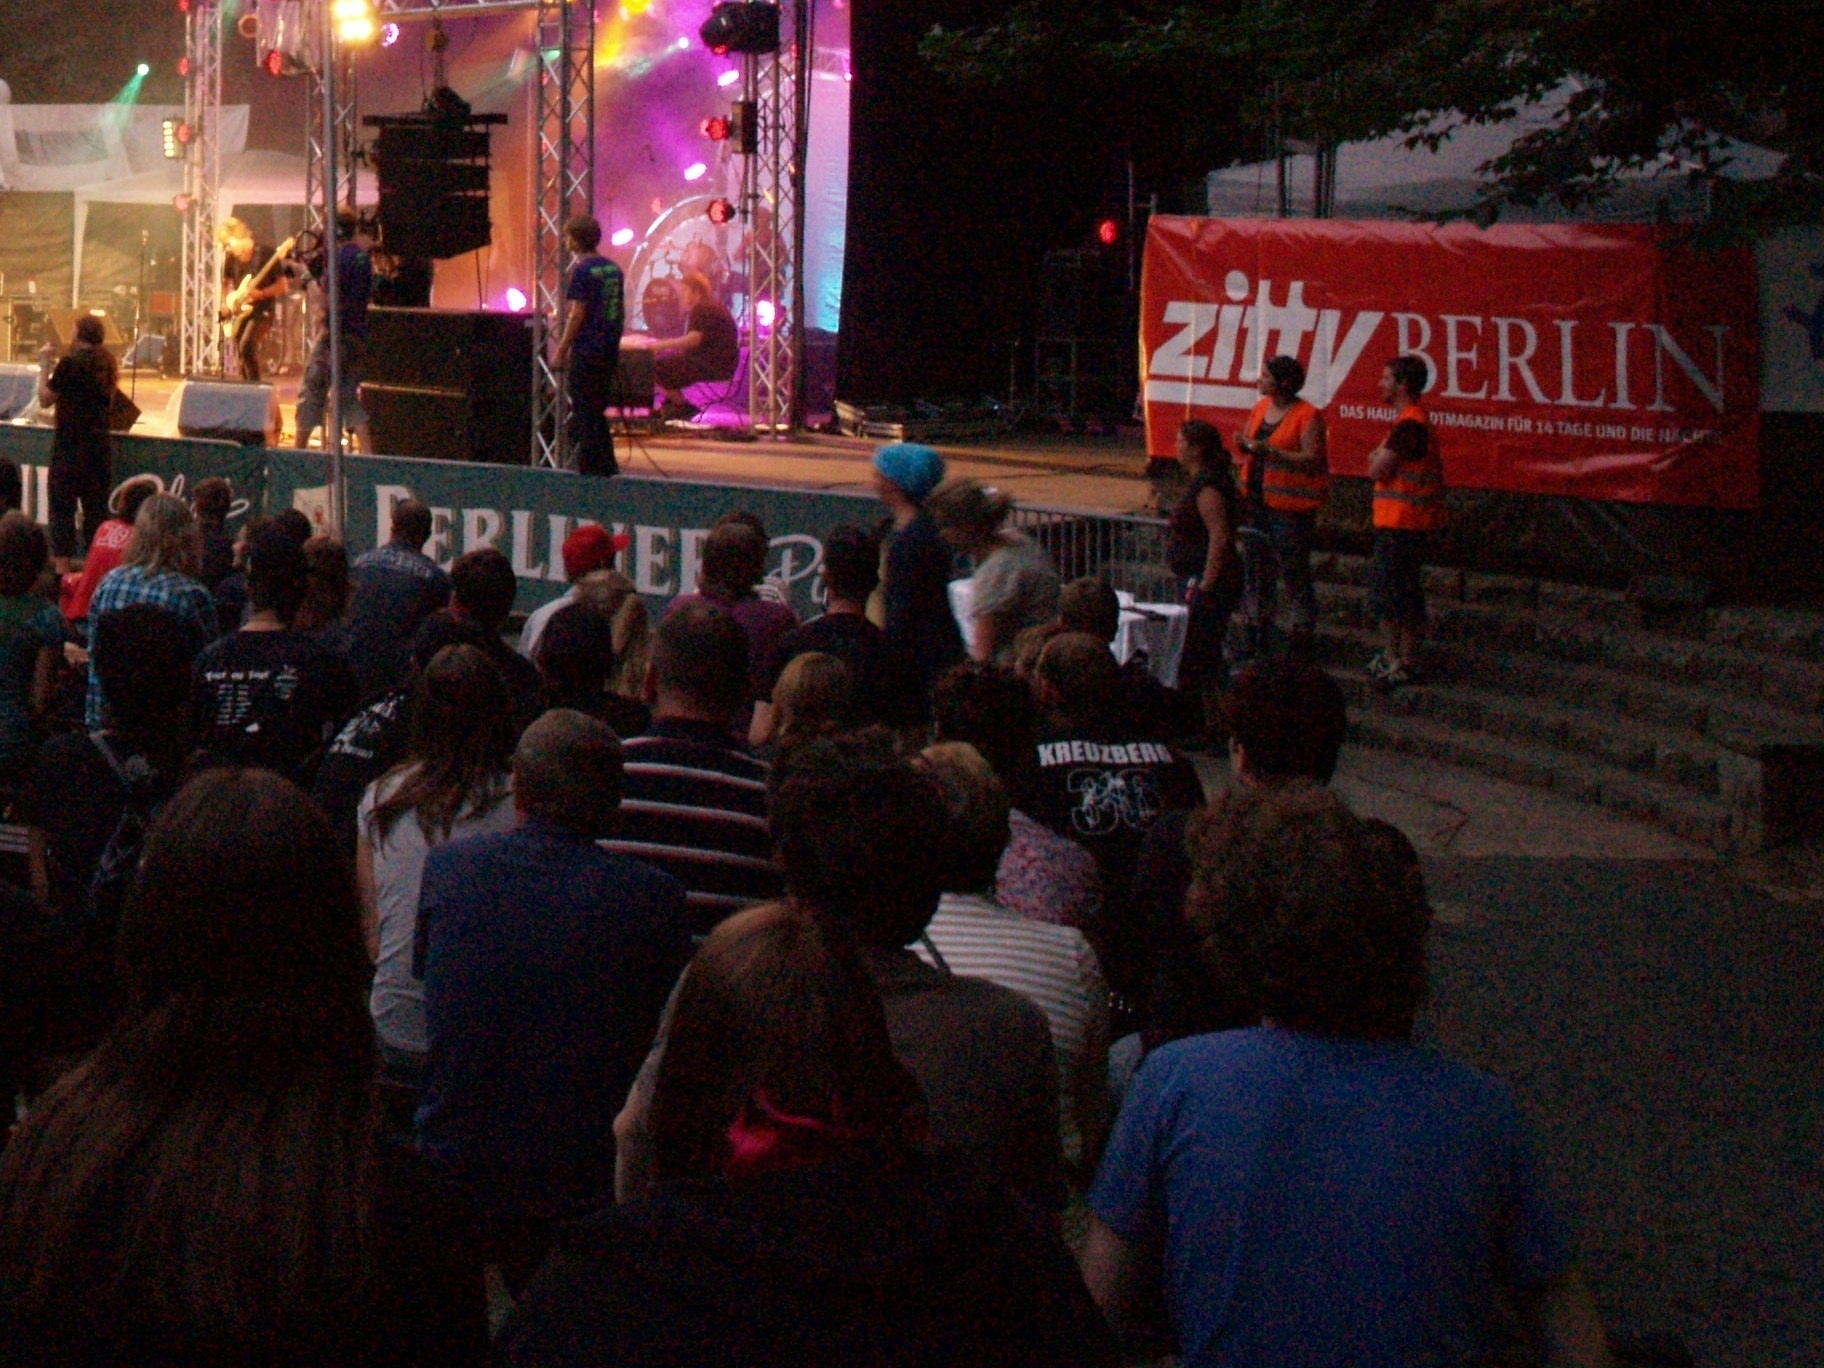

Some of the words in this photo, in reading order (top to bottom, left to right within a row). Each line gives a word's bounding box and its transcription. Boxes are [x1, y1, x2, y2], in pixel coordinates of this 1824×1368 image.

[1146, 270, 1384, 410] zitty
[1391, 311, 1732, 414] BERLIN
[1340, 405, 1364, 419] DAS
[1507, 416, 1532, 433] FÜR
[1536, 422, 1553, 433] 14
[1555, 421, 1592, 437] TAGE
[1596, 425, 1626, 440] UND
[1631, 427, 1655, 442] DIE
